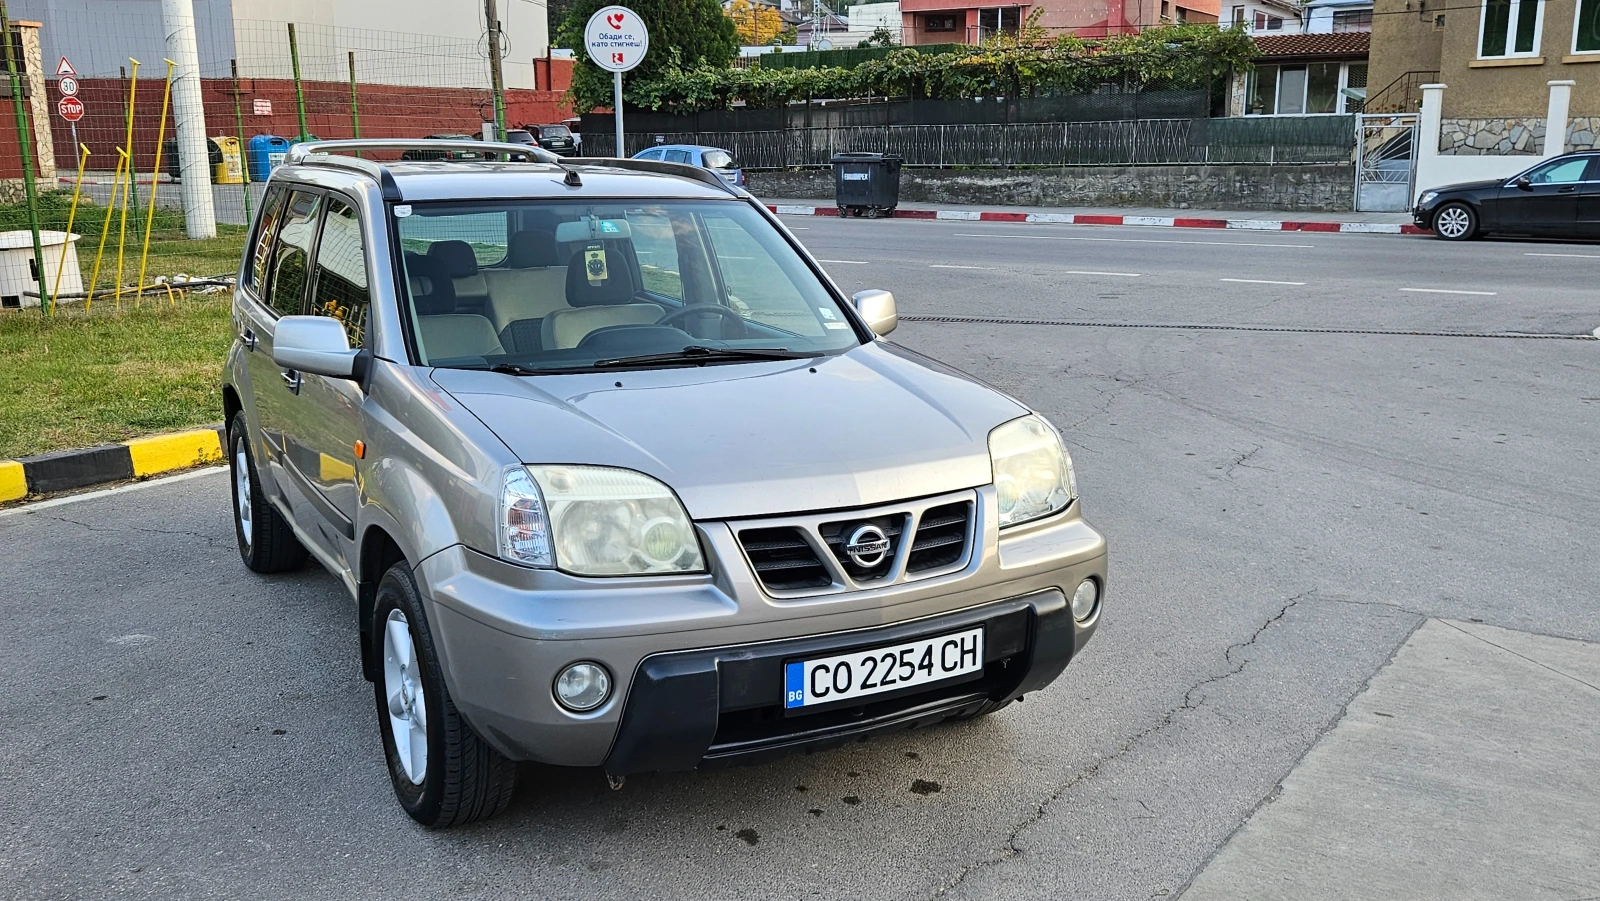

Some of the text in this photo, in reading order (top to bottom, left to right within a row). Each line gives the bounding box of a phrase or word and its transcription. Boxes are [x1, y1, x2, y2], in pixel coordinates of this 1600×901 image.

[598, 33, 622, 41] Обади
[610, 40, 643, 48] стигнеш!
[63, 81, 75, 92] 30
[61, 104, 81, 114] STOP
[853, 540, 889, 553] NISSAN
[810, 634, 977, 699] CO 2254 CH
[788, 690, 803, 702] BG
